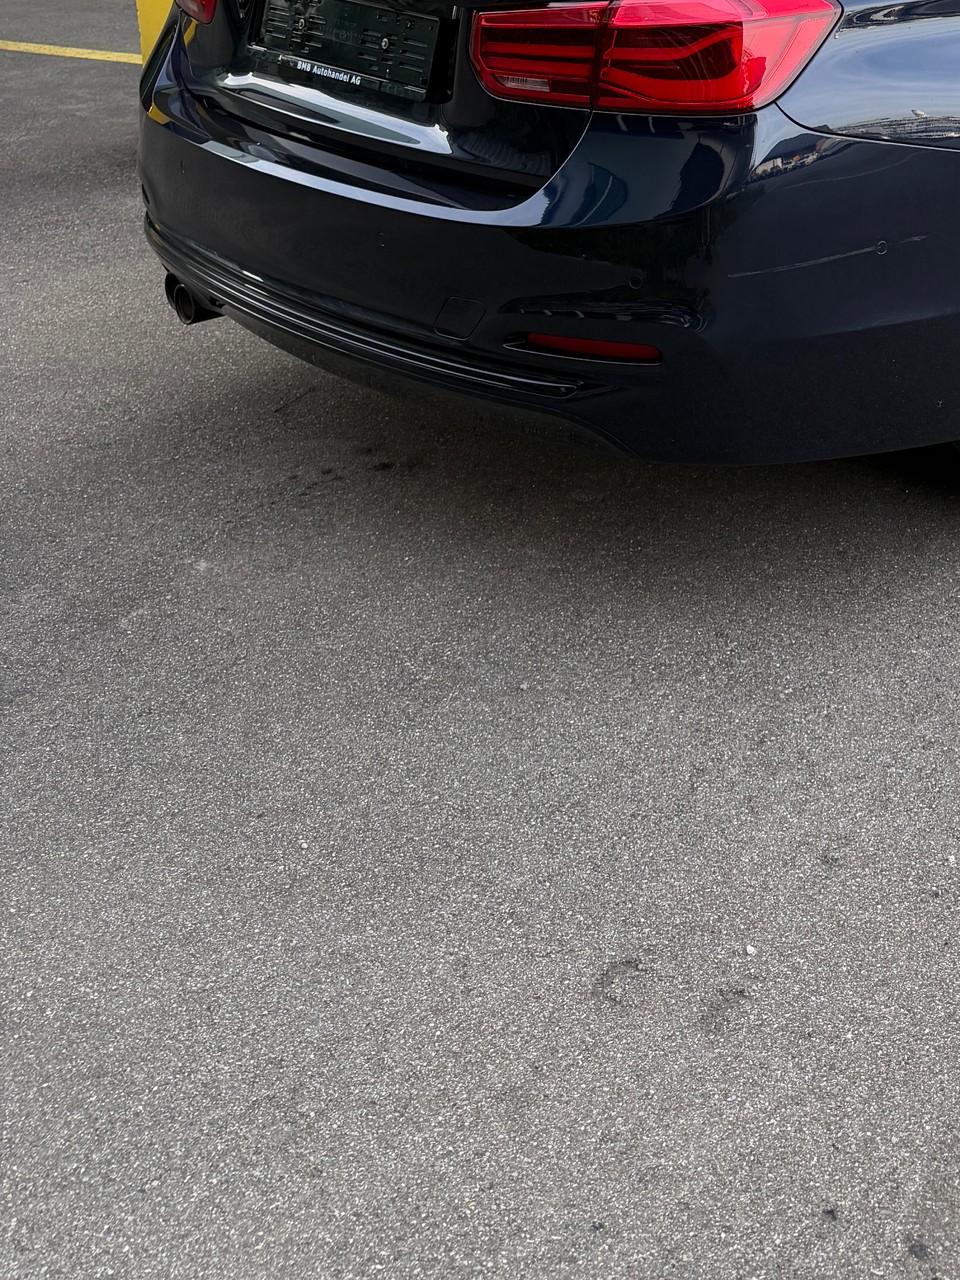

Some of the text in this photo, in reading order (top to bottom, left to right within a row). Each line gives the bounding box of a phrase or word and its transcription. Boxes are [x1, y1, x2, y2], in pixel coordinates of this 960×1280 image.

[297, 60, 361, 86] BMB Autohandel AG
